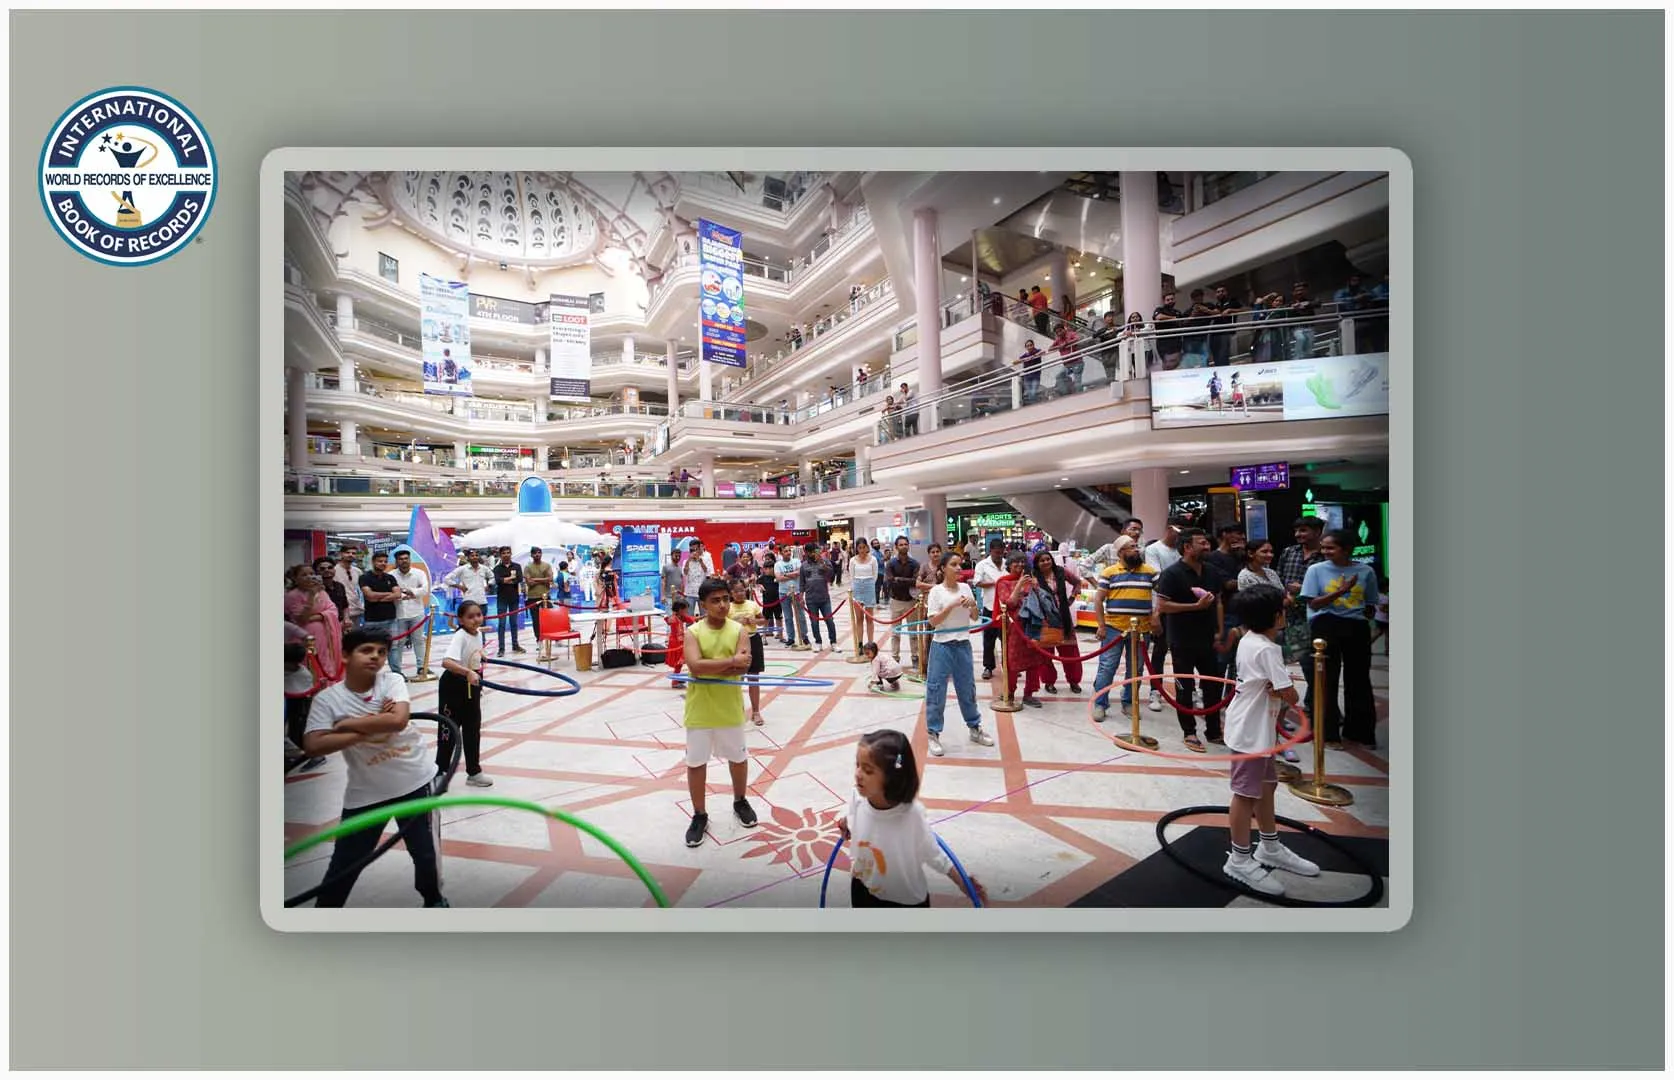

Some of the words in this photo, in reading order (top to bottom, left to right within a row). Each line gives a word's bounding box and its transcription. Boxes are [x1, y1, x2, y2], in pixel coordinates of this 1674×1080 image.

[476, 297, 497, 310] PVR
[625, 524, 660, 534] MART
[626, 544, 655, 552] SPACE
